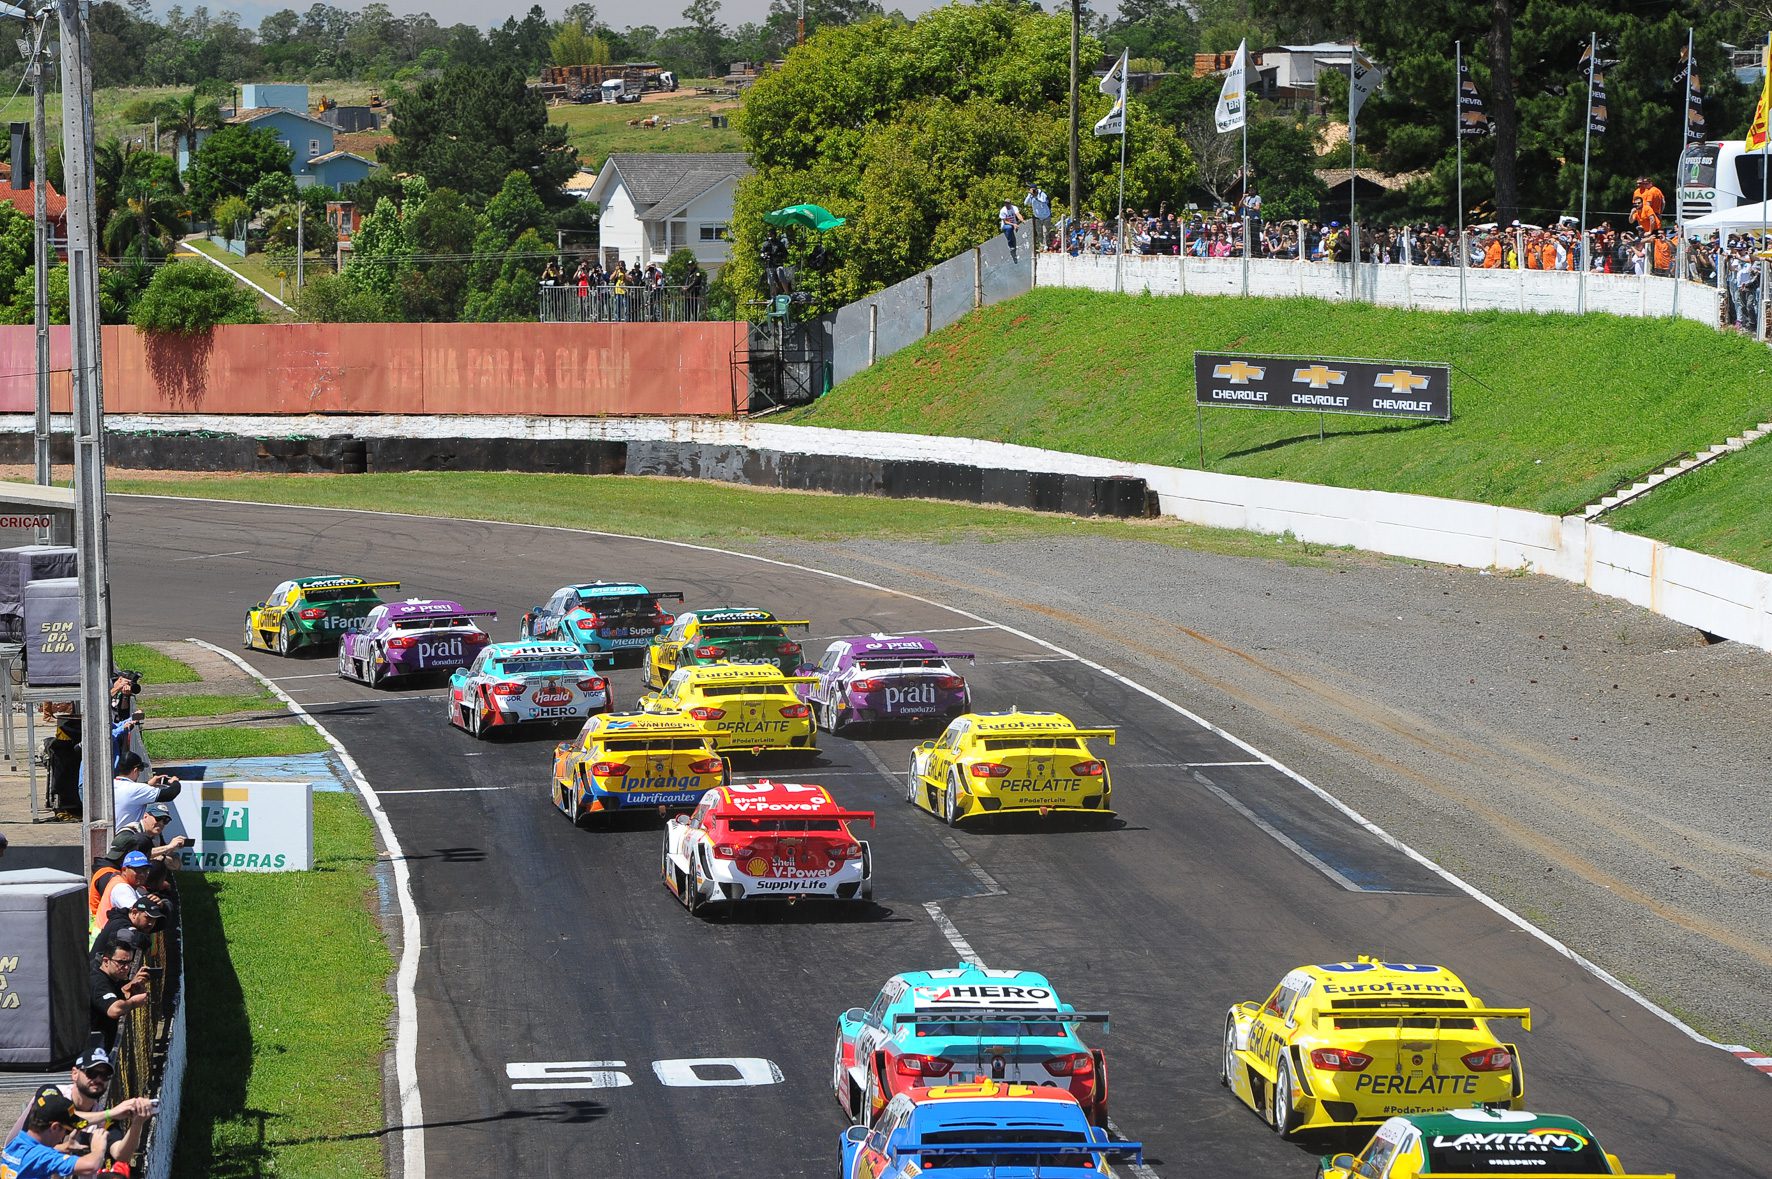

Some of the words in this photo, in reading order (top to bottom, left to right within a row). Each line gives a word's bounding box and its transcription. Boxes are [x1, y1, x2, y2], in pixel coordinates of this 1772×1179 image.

[1212, 389, 1268, 402] CHEVROLET
[1291, 393, 1349, 407] CHEVROLET
[1372, 398, 1433, 412] CHEVROLET
[41, 622, 74, 633] SOM
[323, 616, 367, 630] 1Farm
[47, 633, 68, 643] DA
[630, 627, 655, 637] Super
[40, 643, 76, 653] ILHA
[418, 637, 462, 669] prati
[696, 669, 782, 679] Eurofarma
[534, 691, 571, 704] Harald
[885, 683, 935, 713] prati
[542, 707, 577, 717] HERO
[717, 720, 790, 732] PERLATTE
[976, 721, 1072, 730] Eurofarma
[620, 774, 702, 793] Ipiranga
[1000, 778, 1081, 792] PERLATTE
[626, 792, 696, 804] Lubrificantes
[734, 802, 821, 811] V-Power
[205, 806, 245, 828] BR
[772, 857, 796, 867] Shell
[772, 867, 832, 878] V-Power
[953, 986, 1049, 999] HERO
[1323, 982, 1465, 993] Eurofarma
[506, 1057, 785, 1090] 50
[1355, 1074, 1480, 1094] PERLATTE
[1433, 1133, 1570, 1149] LAVITAN
